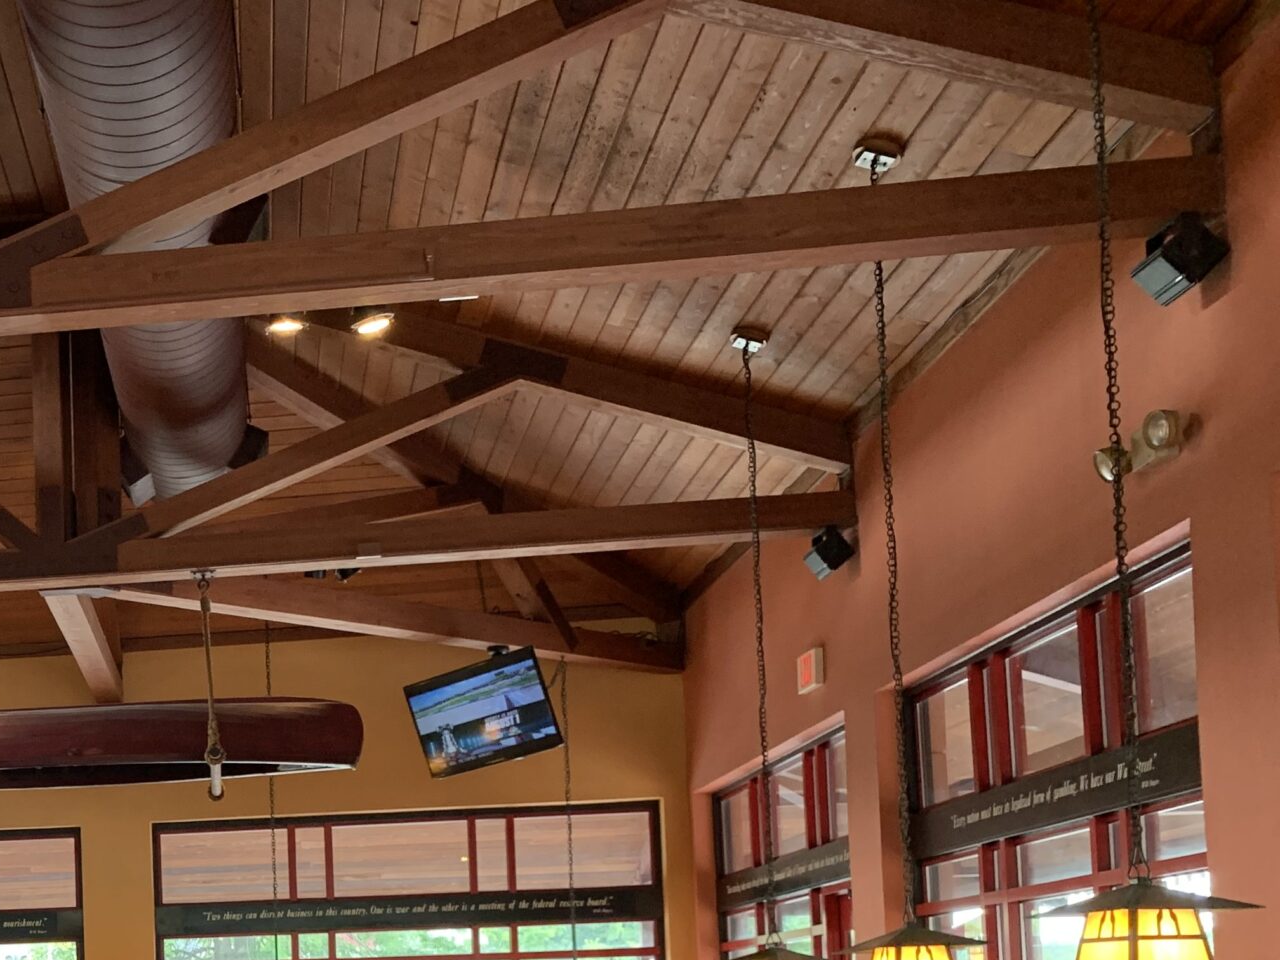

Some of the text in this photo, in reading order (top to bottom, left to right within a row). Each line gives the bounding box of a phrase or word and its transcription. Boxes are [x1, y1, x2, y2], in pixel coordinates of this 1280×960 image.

[223, 910, 243, 921] things
[259, 909, 284, 919] disrpt
[286, 908, 313, 918] business
[316, 908, 323, 917] in
[325, 907, 338, 917] this
[370, 905, 384, 914] One
[386, 905, 392, 914] is
[395, 906, 409, 914] war
[412, 903, 426, 913] and
[428, 903, 439, 913] the
[441, 903, 459, 912] other
[461, 902, 468, 911] is
[478, 901, 506, 912] meeting
[508, 899, 516, 911] of
[519, 899, 530, 909] the
[531, 898, 556, 909] federal
